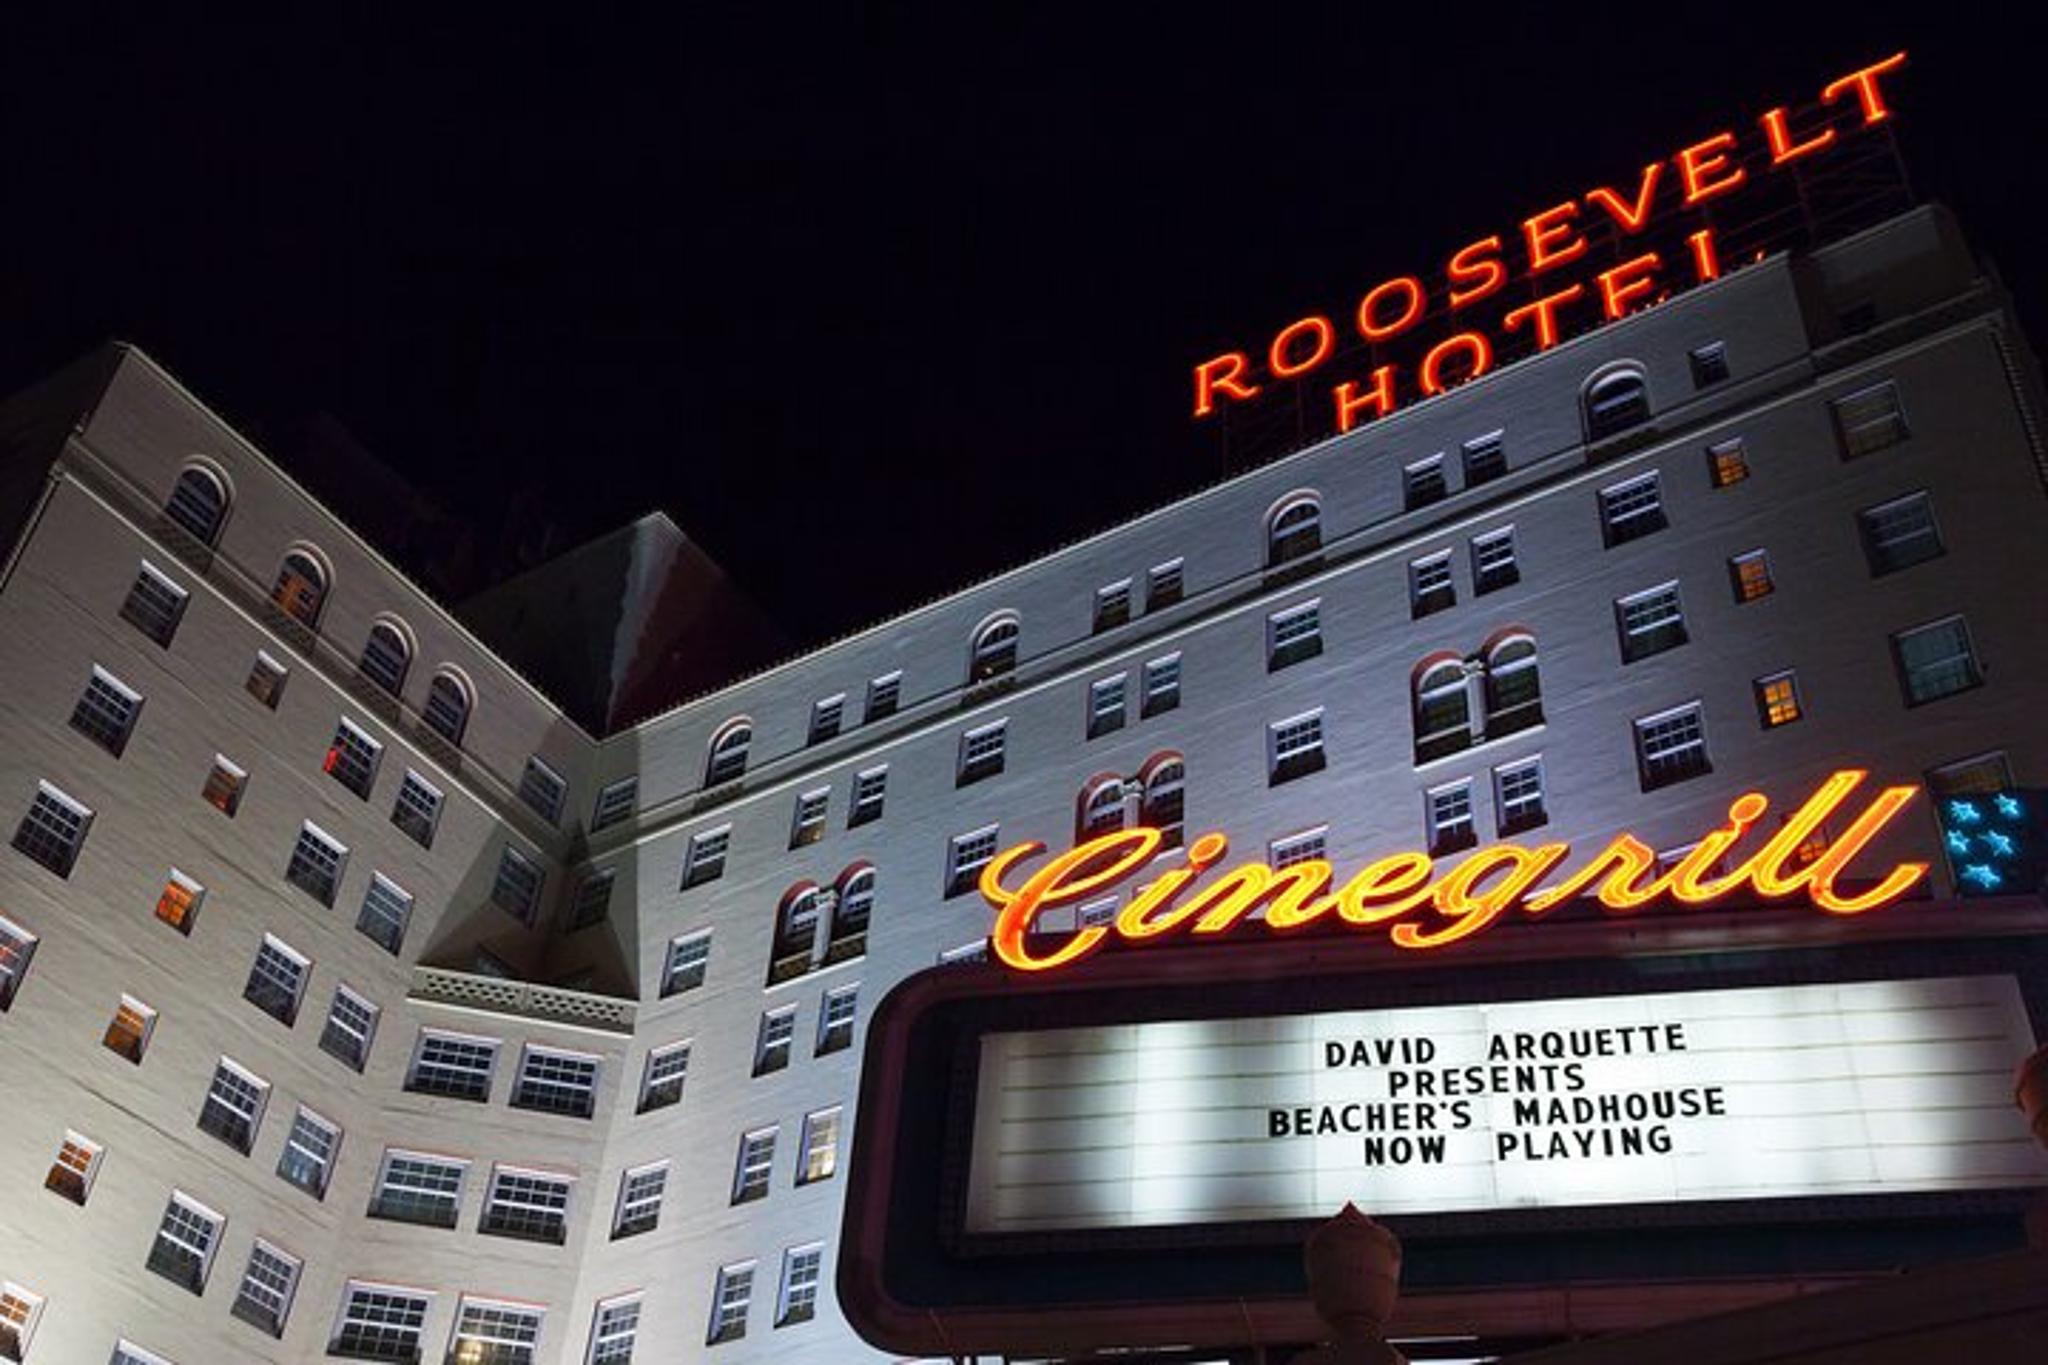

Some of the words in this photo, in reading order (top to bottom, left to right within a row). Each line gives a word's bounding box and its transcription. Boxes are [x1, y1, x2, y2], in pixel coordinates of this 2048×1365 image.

[1192, 50, 1908, 418] ROOSEVELT
[1332, 228, 1768, 434] HOTEL
[977, 768, 1929, 972] Cinegrill
[1325, 1037, 1436, 1068] DAVID
[1488, 1023, 1688, 1063] ARQUETTE
[1388, 1063, 1586, 1098] PRESENTS
[1268, 1100, 1473, 1138] BEACHER'S
[1514, 1087, 1727, 1126] MADHOUSE
[1364, 1136, 1446, 1166] NOW
[1498, 1125, 1672, 1161] PLAYING
